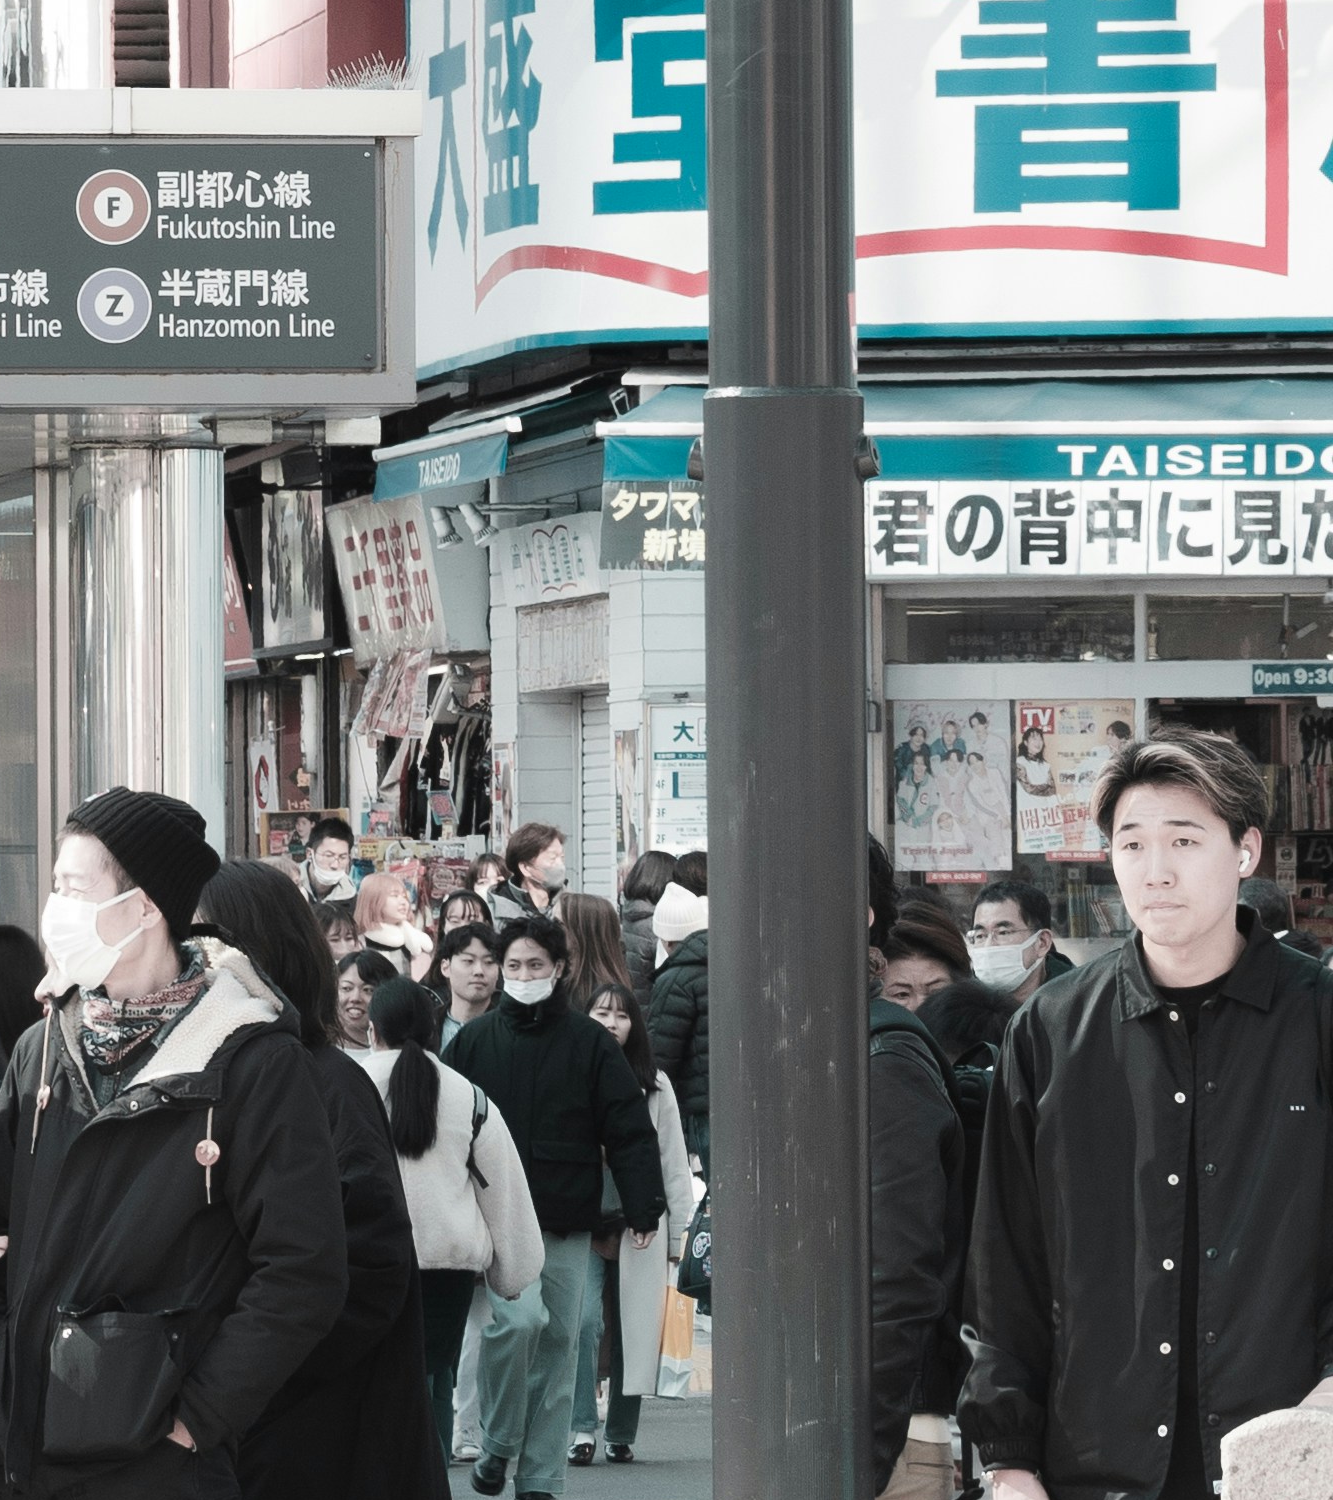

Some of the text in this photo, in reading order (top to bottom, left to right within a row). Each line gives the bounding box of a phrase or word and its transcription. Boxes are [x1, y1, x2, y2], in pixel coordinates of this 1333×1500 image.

[156, 170, 312, 209] 副都心線
[105, 196, 123, 219] F
[156, 214, 336, 240] Fukutoshin Line
[157, 268, 310, 308] 半蔵門線
[106, 293, 125, 317] Z
[15, 312, 63, 339] Line
[158, 312, 336, 340] Hanzomon Line
[417, 450, 462, 489] TAISEIDO
[1056, 443, 1333, 477] TAISEID
[610, 488, 706, 522] タワマ
[1254, 669, 1291, 688] Open
[673, 720, 695, 742] 大
[1022, 708, 1053, 729] TV
